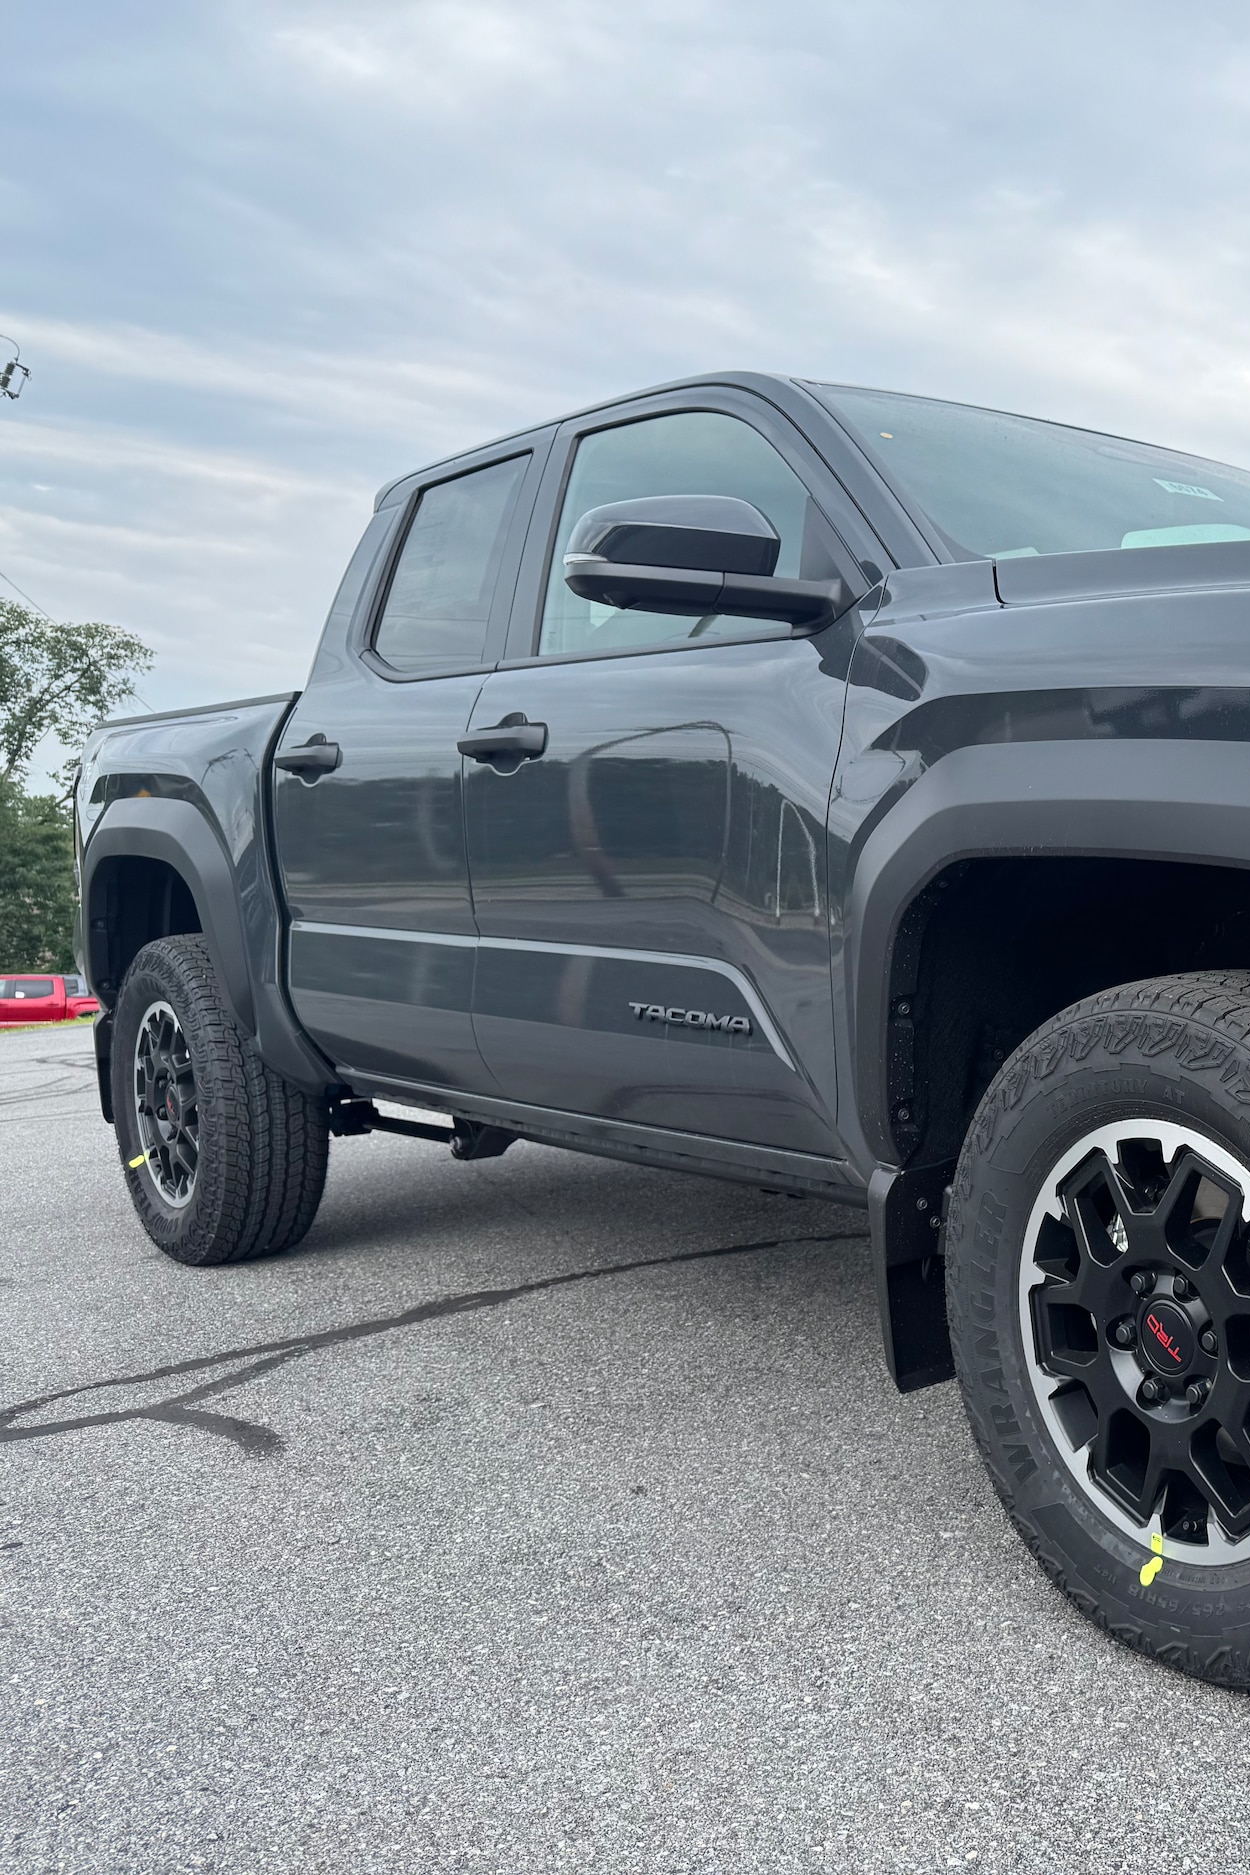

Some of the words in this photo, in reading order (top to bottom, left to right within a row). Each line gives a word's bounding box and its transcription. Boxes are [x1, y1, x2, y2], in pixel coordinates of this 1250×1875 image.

[628, 1001, 752, 1035] TACOMA
[1046, 1078, 1148, 1119] TERRITORY
[1162, 1085, 1186, 1105] AT
[970, 1191, 1039, 1487] WRANGLER
[1146, 1313, 1182, 1363] TRD
[1126, 1583, 1226, 1618] 265/65R18
